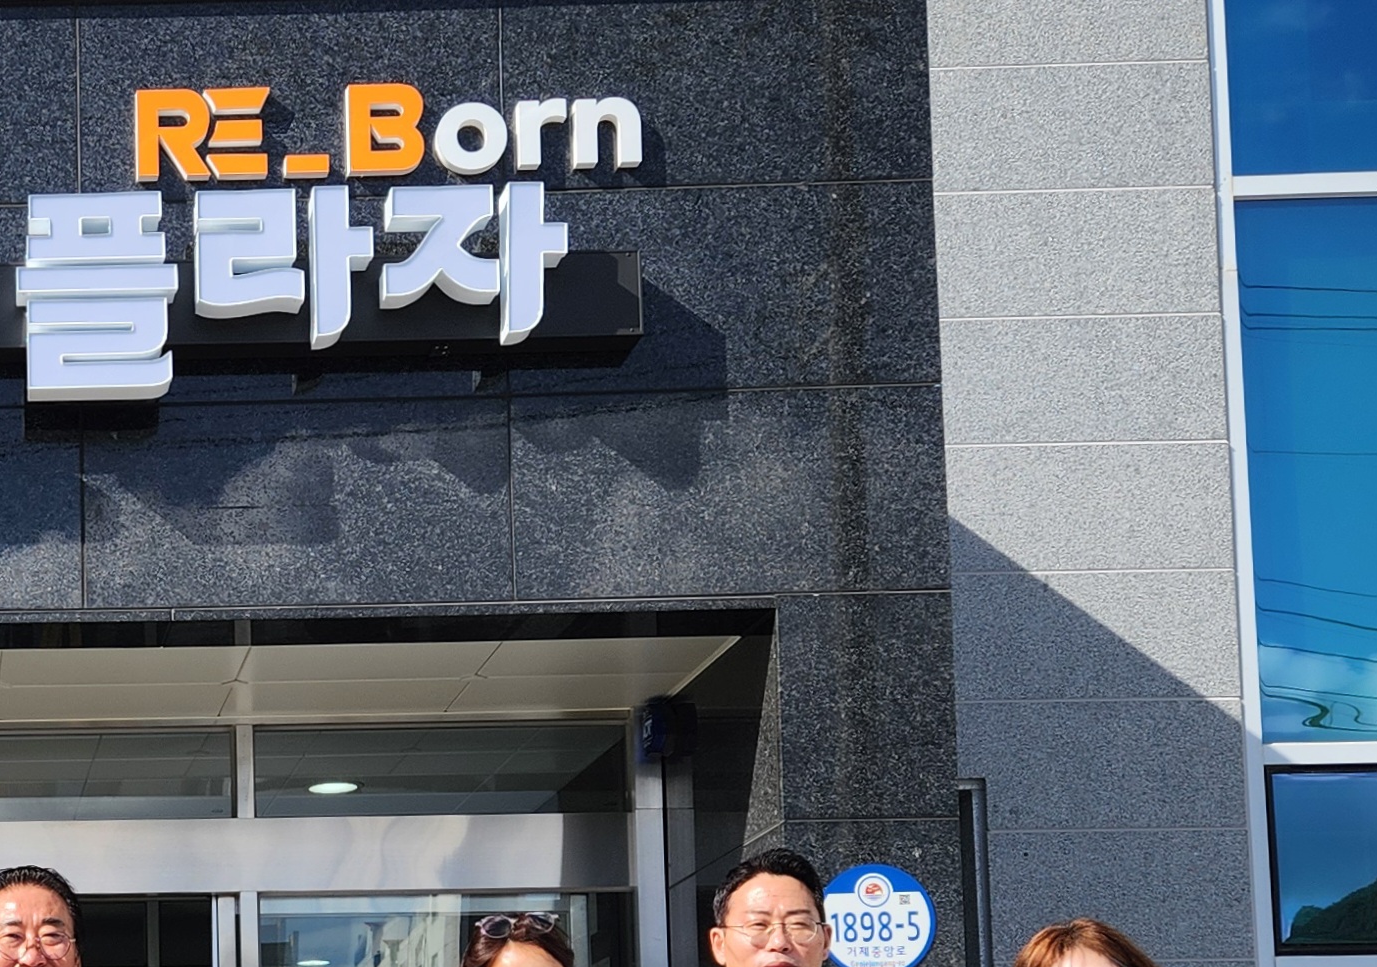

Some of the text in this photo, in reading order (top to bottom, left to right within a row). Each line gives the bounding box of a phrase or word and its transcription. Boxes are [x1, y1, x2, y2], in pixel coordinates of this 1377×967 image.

[15, 181, 569, 402] 플라자
[830, 910, 921, 943] 1898-5
[847, 945, 907, 959] 거제중앙로
